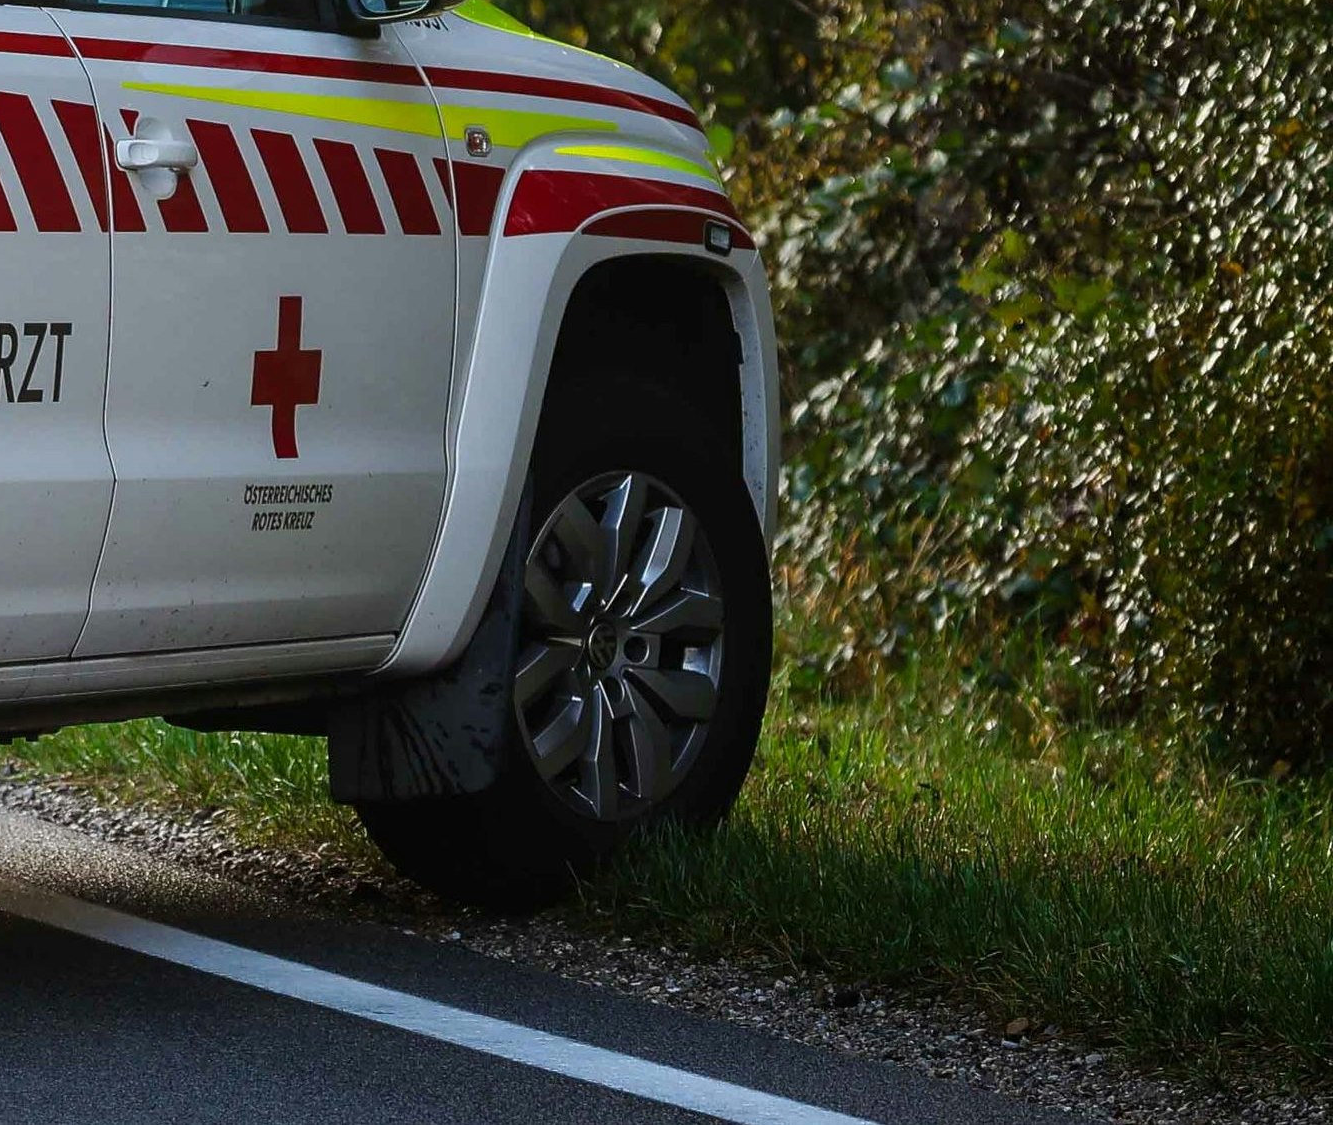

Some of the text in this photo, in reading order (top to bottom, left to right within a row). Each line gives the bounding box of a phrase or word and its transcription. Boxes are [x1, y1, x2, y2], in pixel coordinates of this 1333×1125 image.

[244, 484, 333, 505] ÖSTERREICHISCHES
[251, 511, 315, 531] ROTES KREUZ
